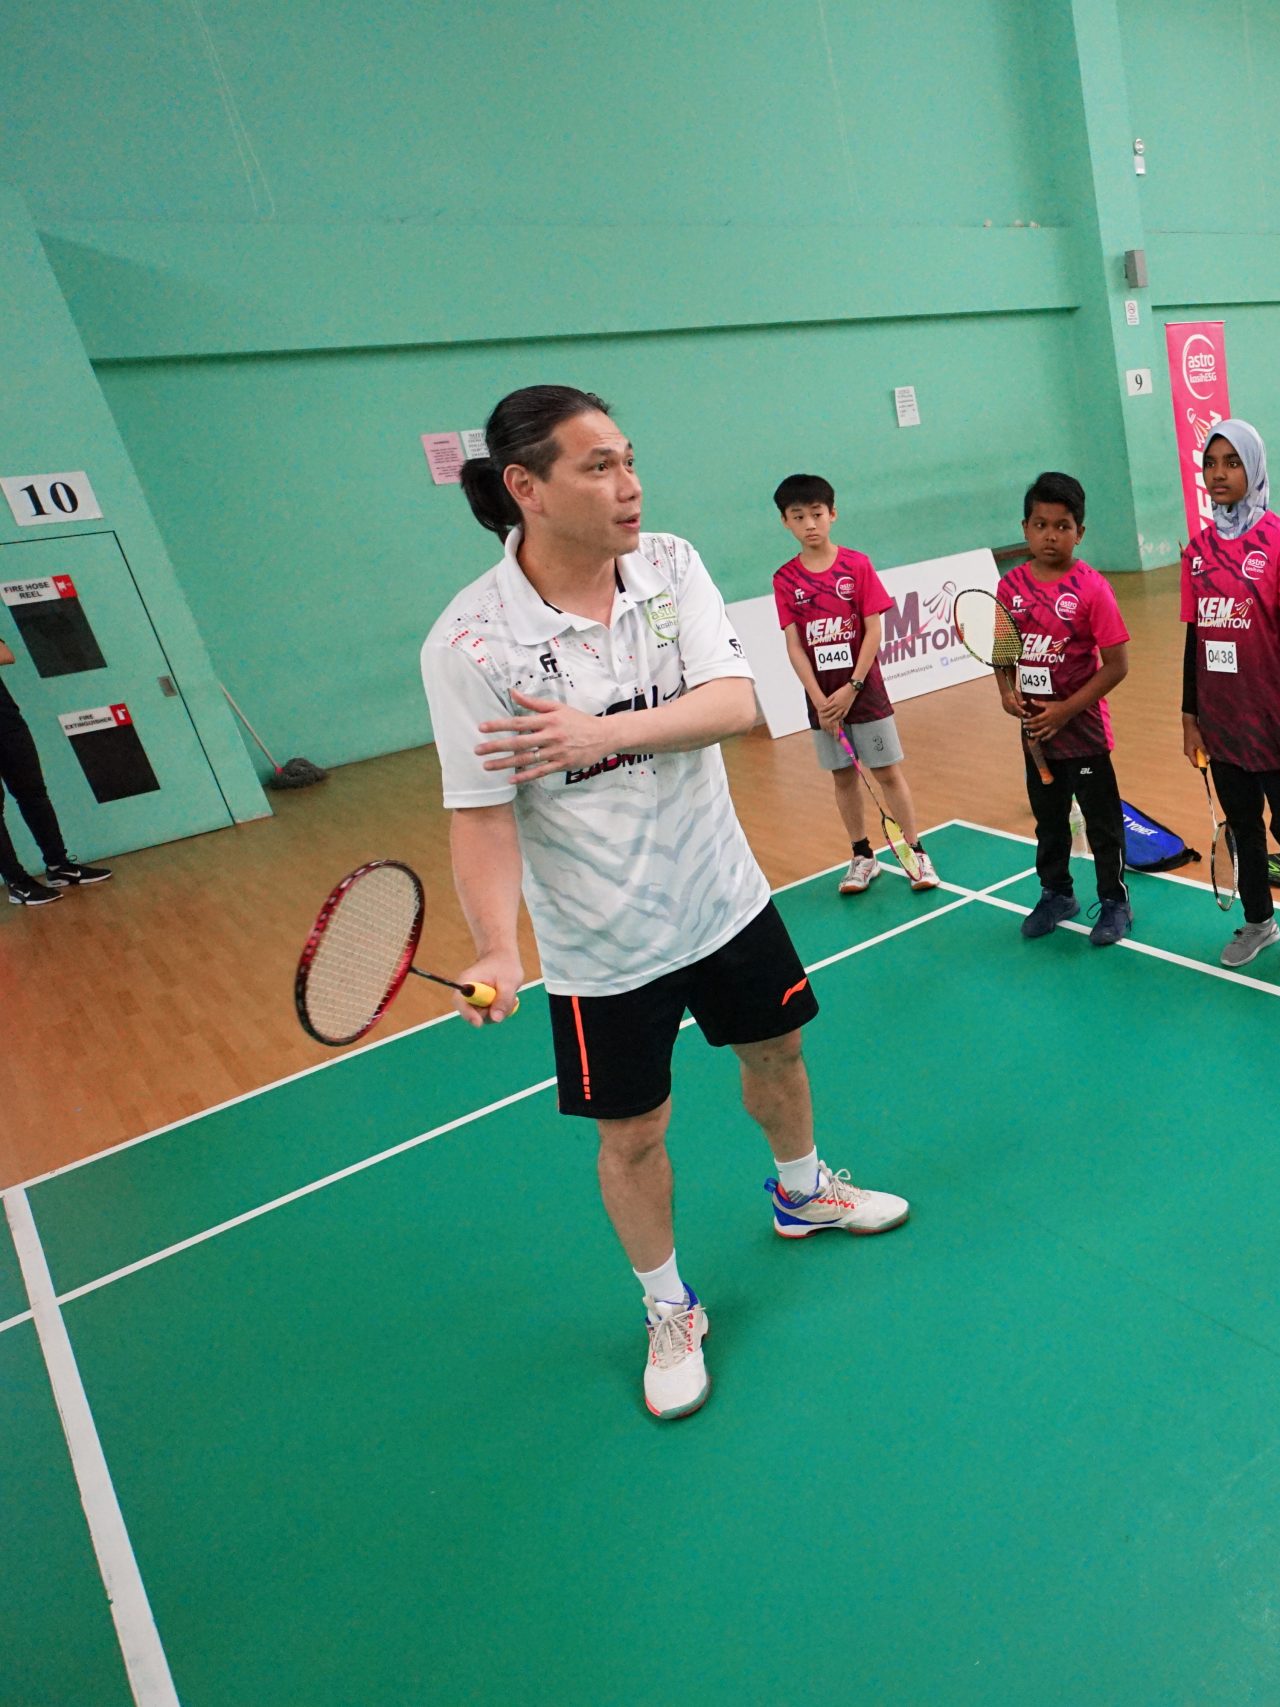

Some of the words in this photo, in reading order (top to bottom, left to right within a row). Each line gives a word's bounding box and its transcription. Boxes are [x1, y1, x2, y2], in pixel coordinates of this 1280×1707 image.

[1187, 352, 1216, 369] astro
[1134, 373, 1144, 392] 9
[20, 481, 79, 517] 10
[3, 584, 24, 594] FIRE
[25, 581, 50, 591] HOSE
[19, 590, 43, 600] REEL
[1060, 600, 1078, 609] astro
[1197, 597, 1235, 618] KEM
[806, 616, 843, 639] KEM
[818, 650, 849, 664] 0440
[1208, 649, 1234, 665] 0438
[1021, 673, 1047, 687] 0439
[78, 713, 95, 722] FIRE
[1126, 820, 1159, 837] YONEX
